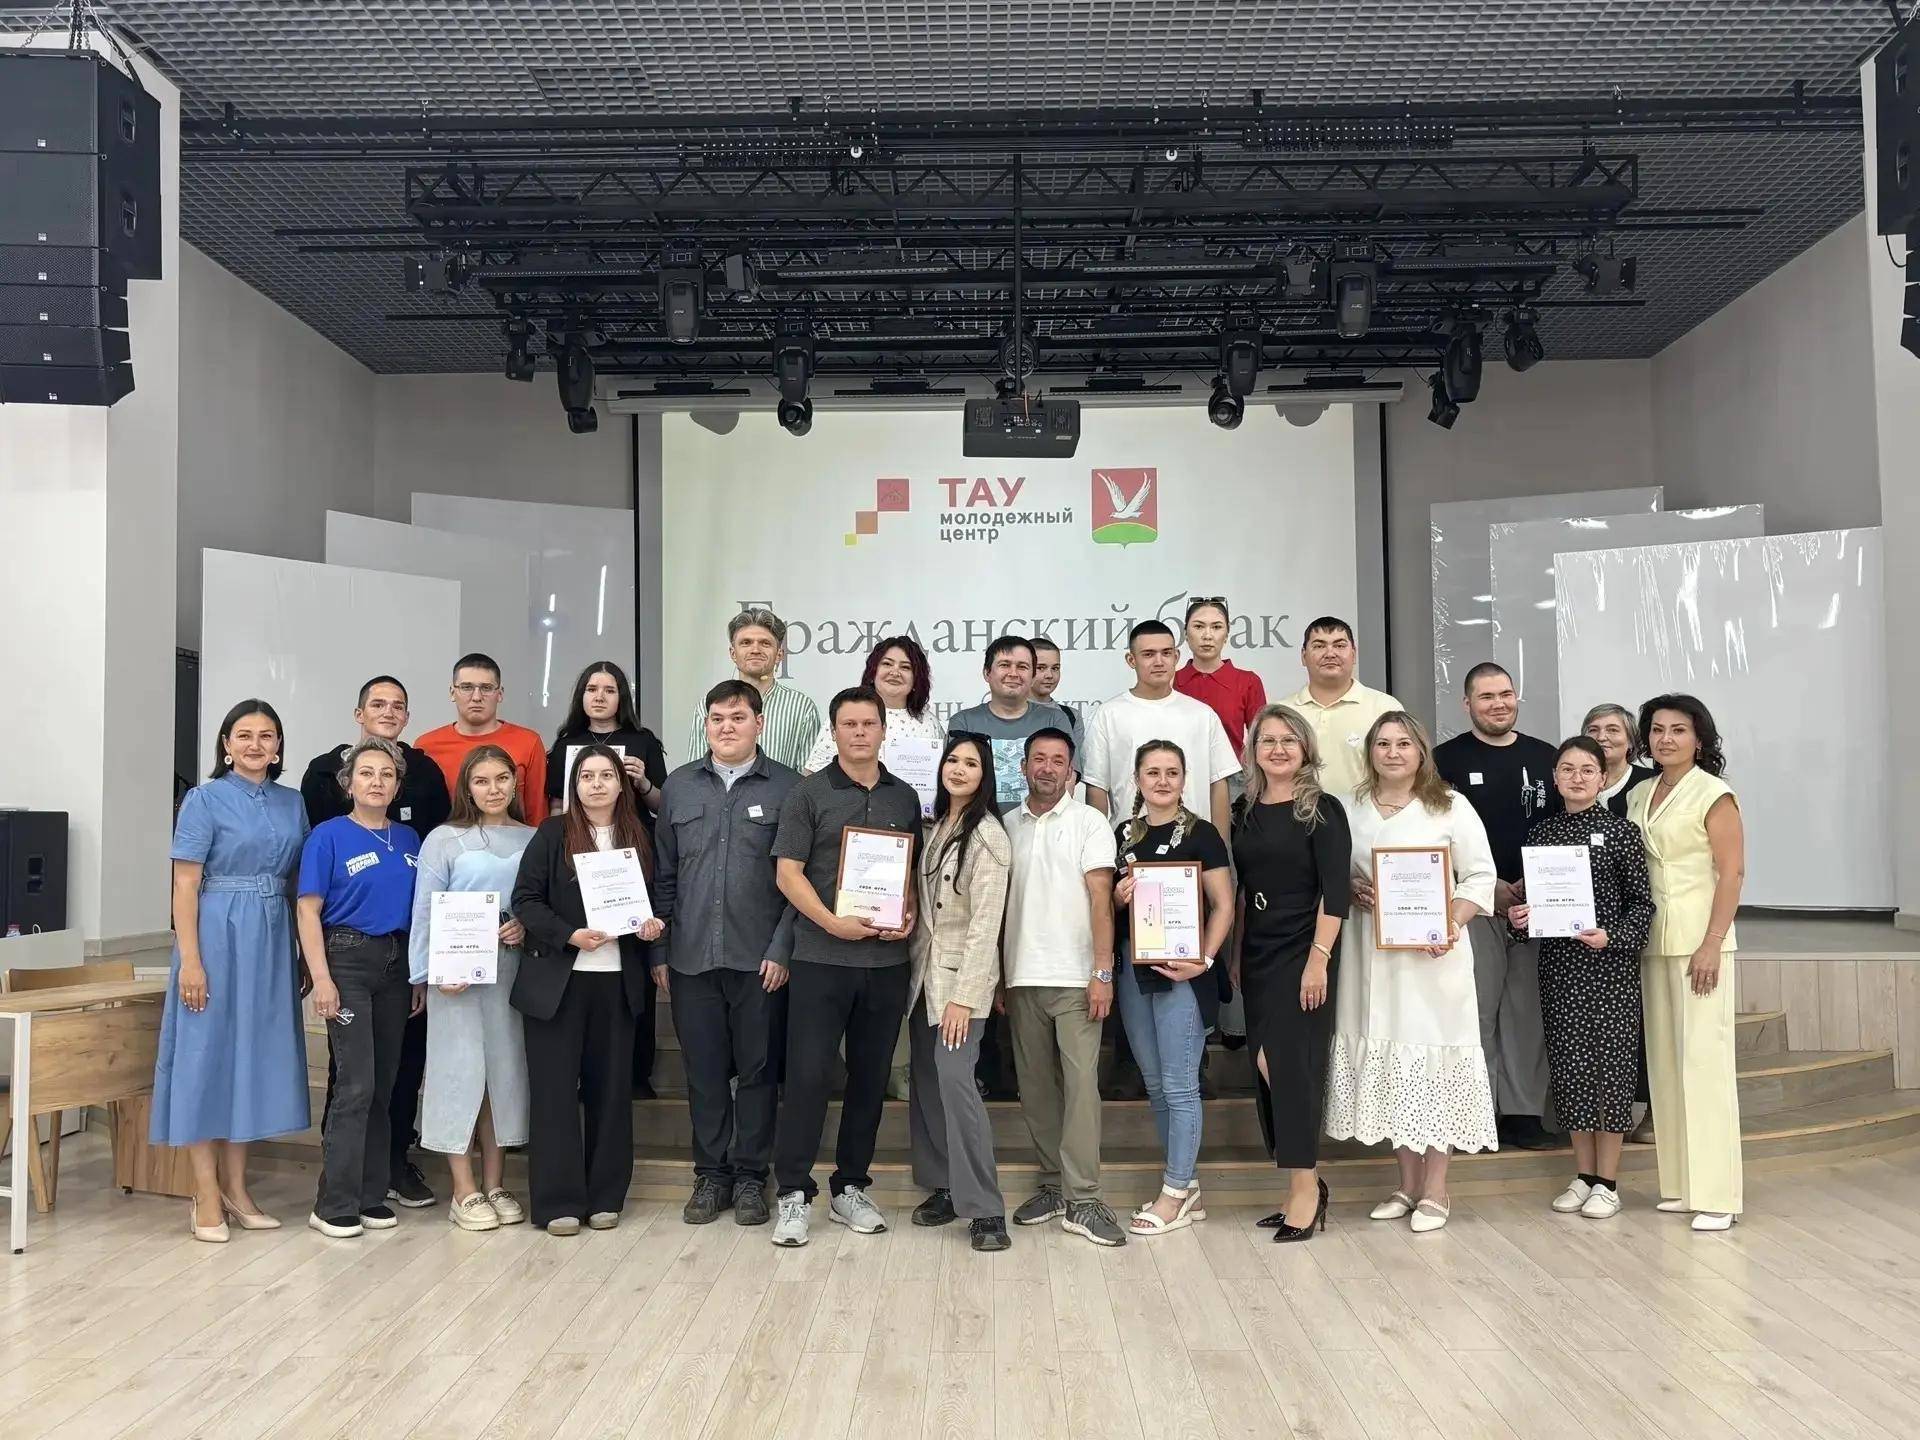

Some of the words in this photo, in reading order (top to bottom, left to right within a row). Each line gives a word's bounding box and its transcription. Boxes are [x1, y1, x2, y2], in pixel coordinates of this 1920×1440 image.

[938, 477, 1026, 507] ТАУ
[940, 507, 1073, 527] молодежный
[940, 528, 999, 544] центр
[1155, 590, 1293, 650] бак
